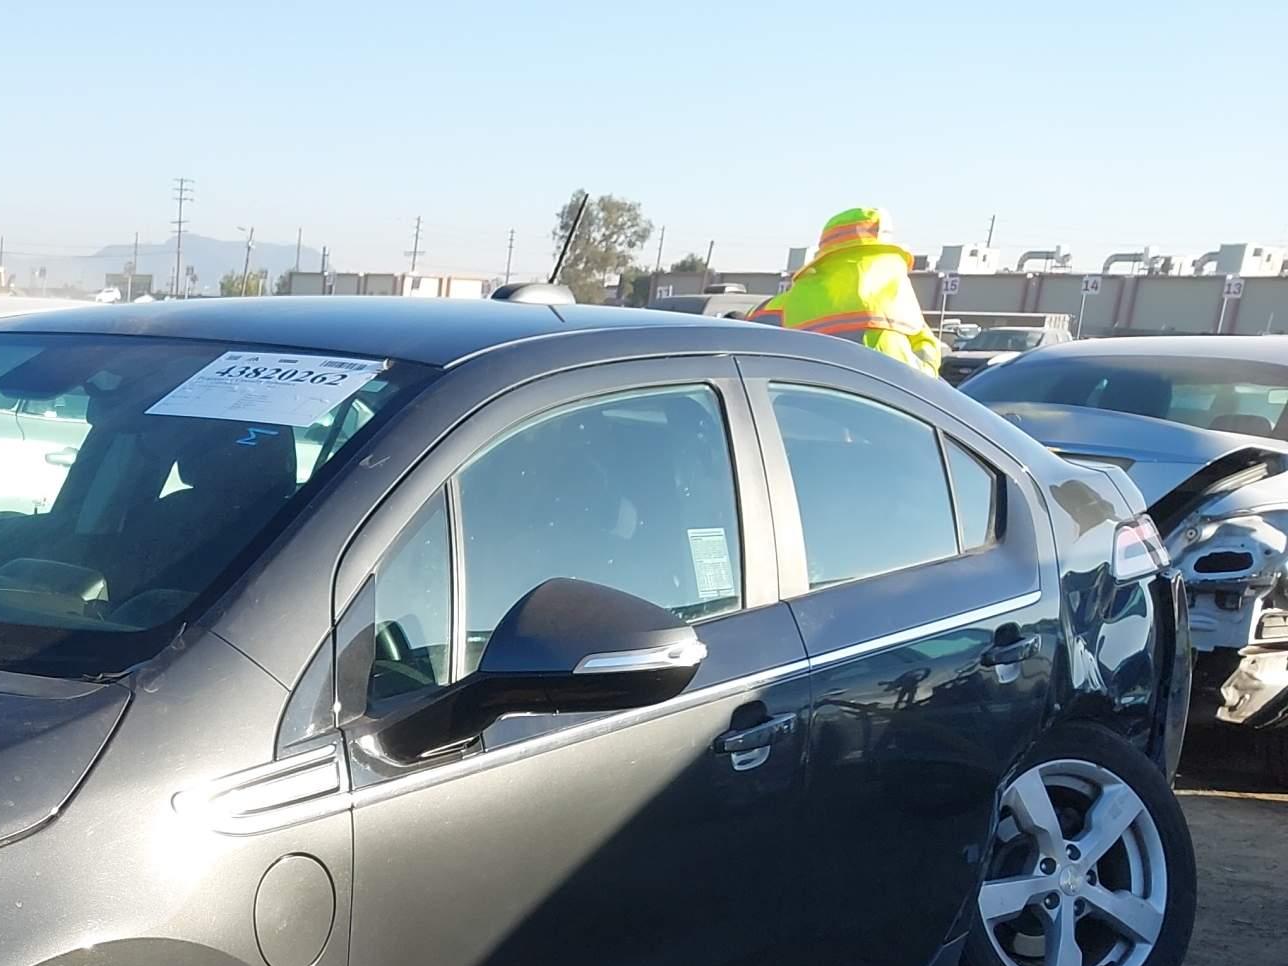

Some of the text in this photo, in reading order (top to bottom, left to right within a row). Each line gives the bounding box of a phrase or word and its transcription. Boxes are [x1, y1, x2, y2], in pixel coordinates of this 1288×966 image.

[943, 279, 958, 292] 15
[1083, 279, 1099, 292] 14
[1224, 282, 1242, 295] 13
[215, 364, 349, 387] 43820262
